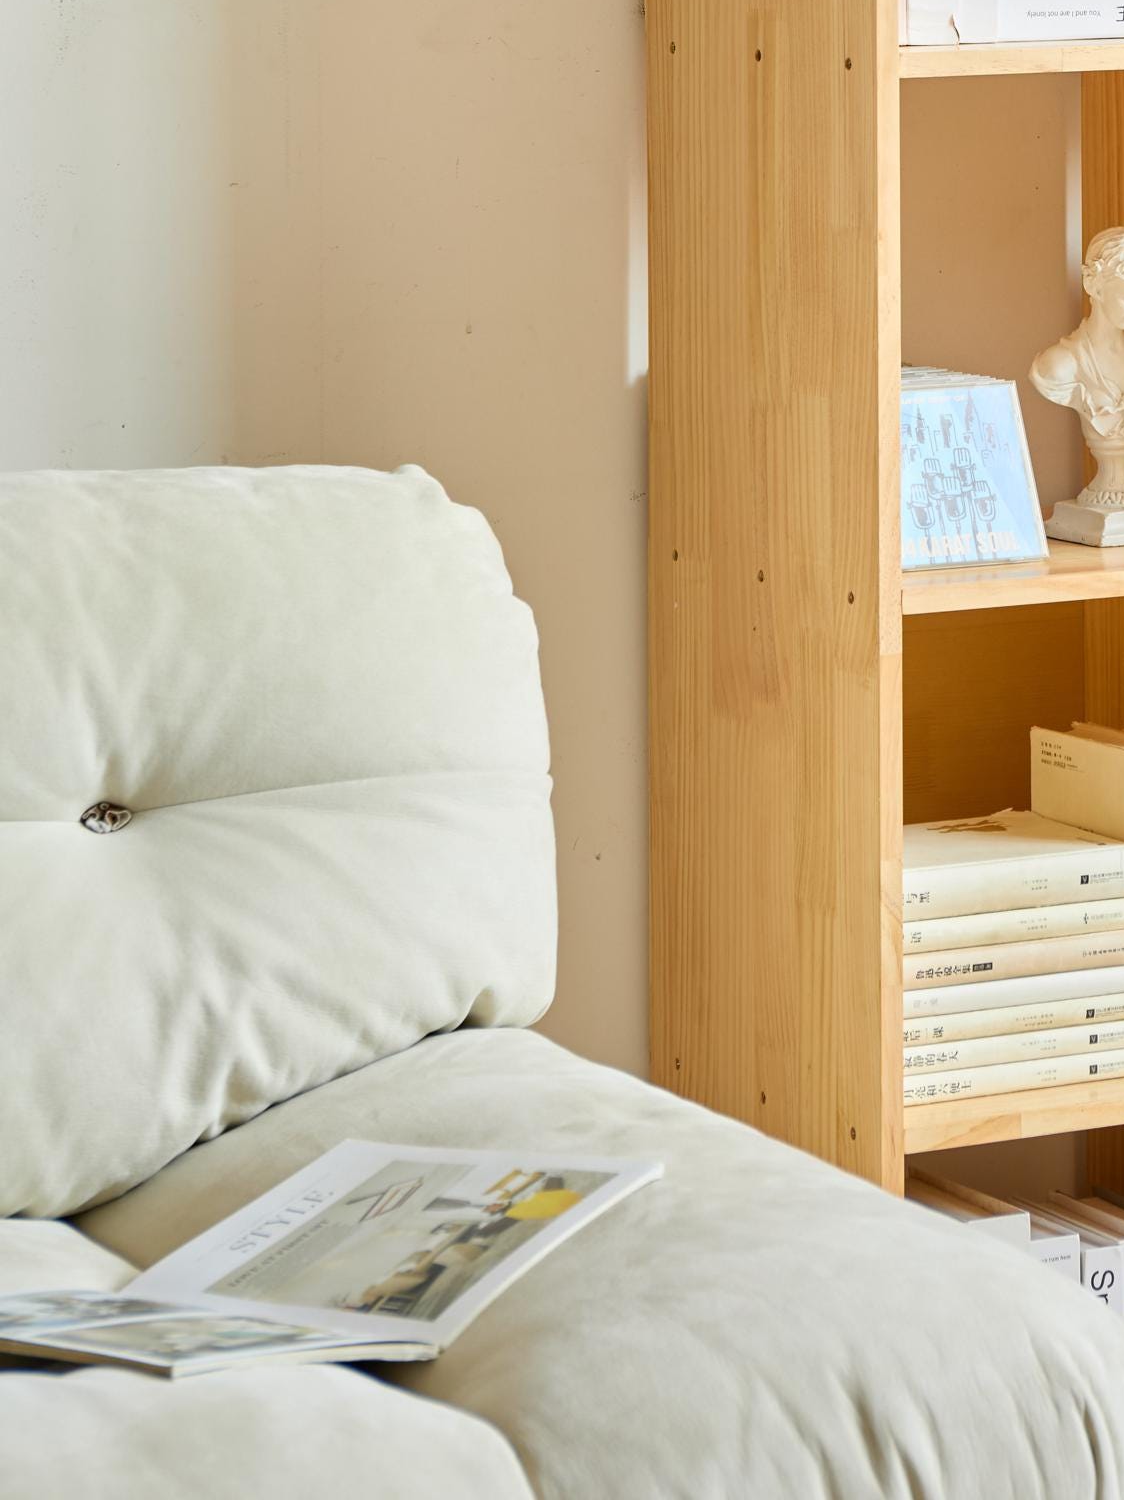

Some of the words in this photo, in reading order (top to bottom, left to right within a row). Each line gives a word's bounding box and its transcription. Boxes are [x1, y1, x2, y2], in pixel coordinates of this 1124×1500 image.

[1088, 10, 1101, 18] You
[903, 892, 930, 903] 与黑
[916, 964, 971, 979] 鲁迅小说全集
